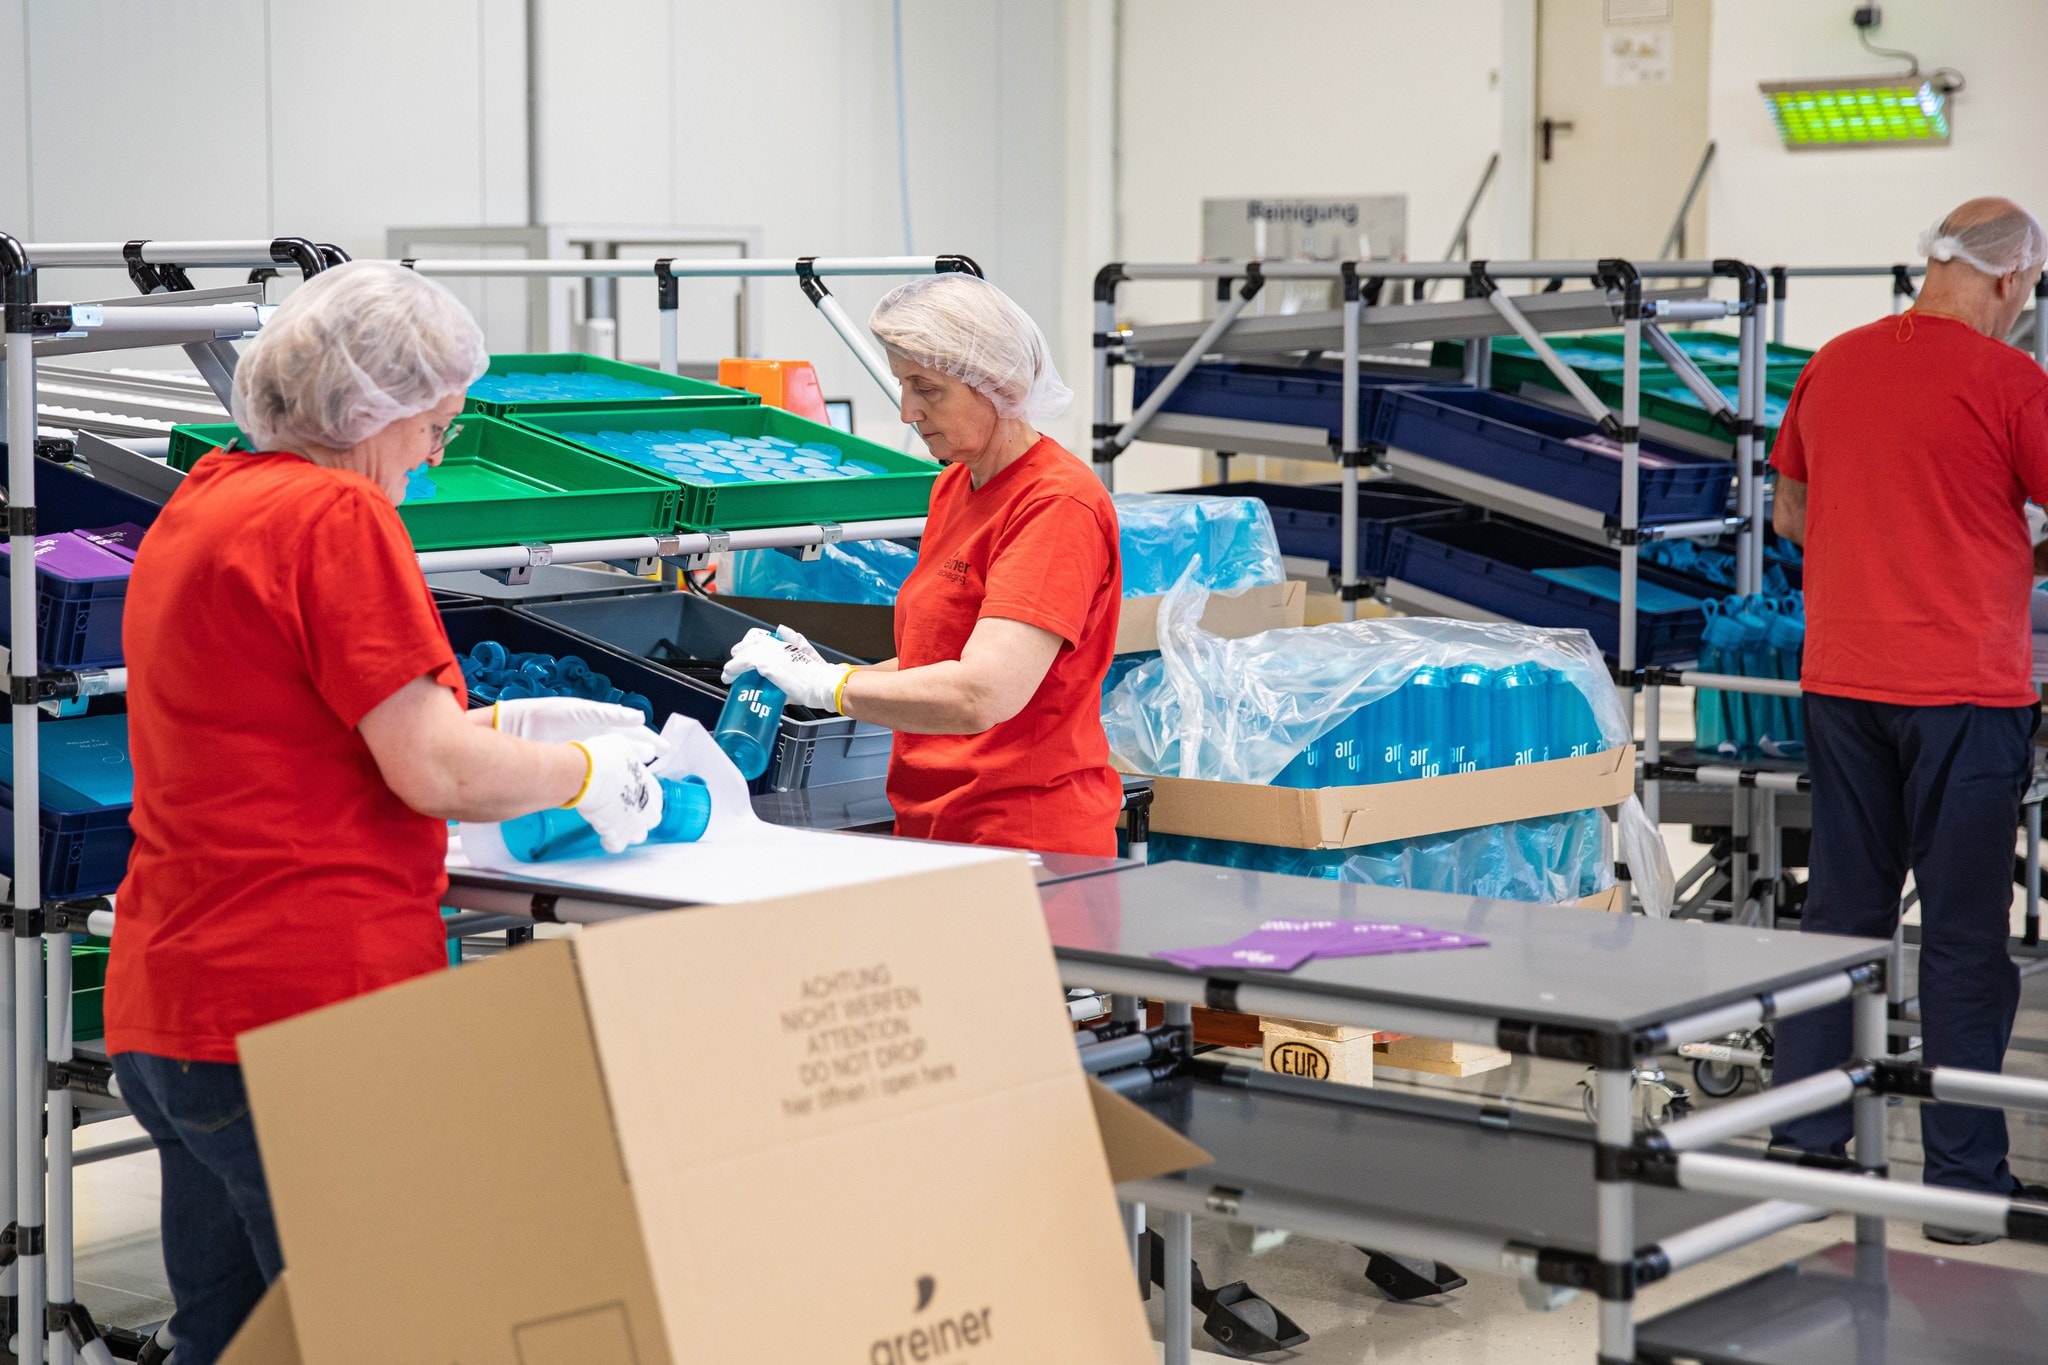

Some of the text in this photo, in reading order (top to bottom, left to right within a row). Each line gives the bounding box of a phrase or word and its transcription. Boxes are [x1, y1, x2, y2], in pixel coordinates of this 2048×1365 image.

[1245, 199, 1359, 227] Reinigung
[737, 688, 764, 702] air
[749, 701, 772, 719] up
[1335, 739, 1355, 759] air
[1385, 744, 1403, 763] air
[1410, 748, 1429, 767] air
[1514, 747, 1534, 766] air
[801, 962, 892, 998] ACHTUNG
[779, 1001, 837, 1033] NICHT
[806, 1015, 911, 1054] ATTENTION
[799, 1037, 928, 1087] DO NOT DROP
[1282, 1048, 1318, 1079] EUR
